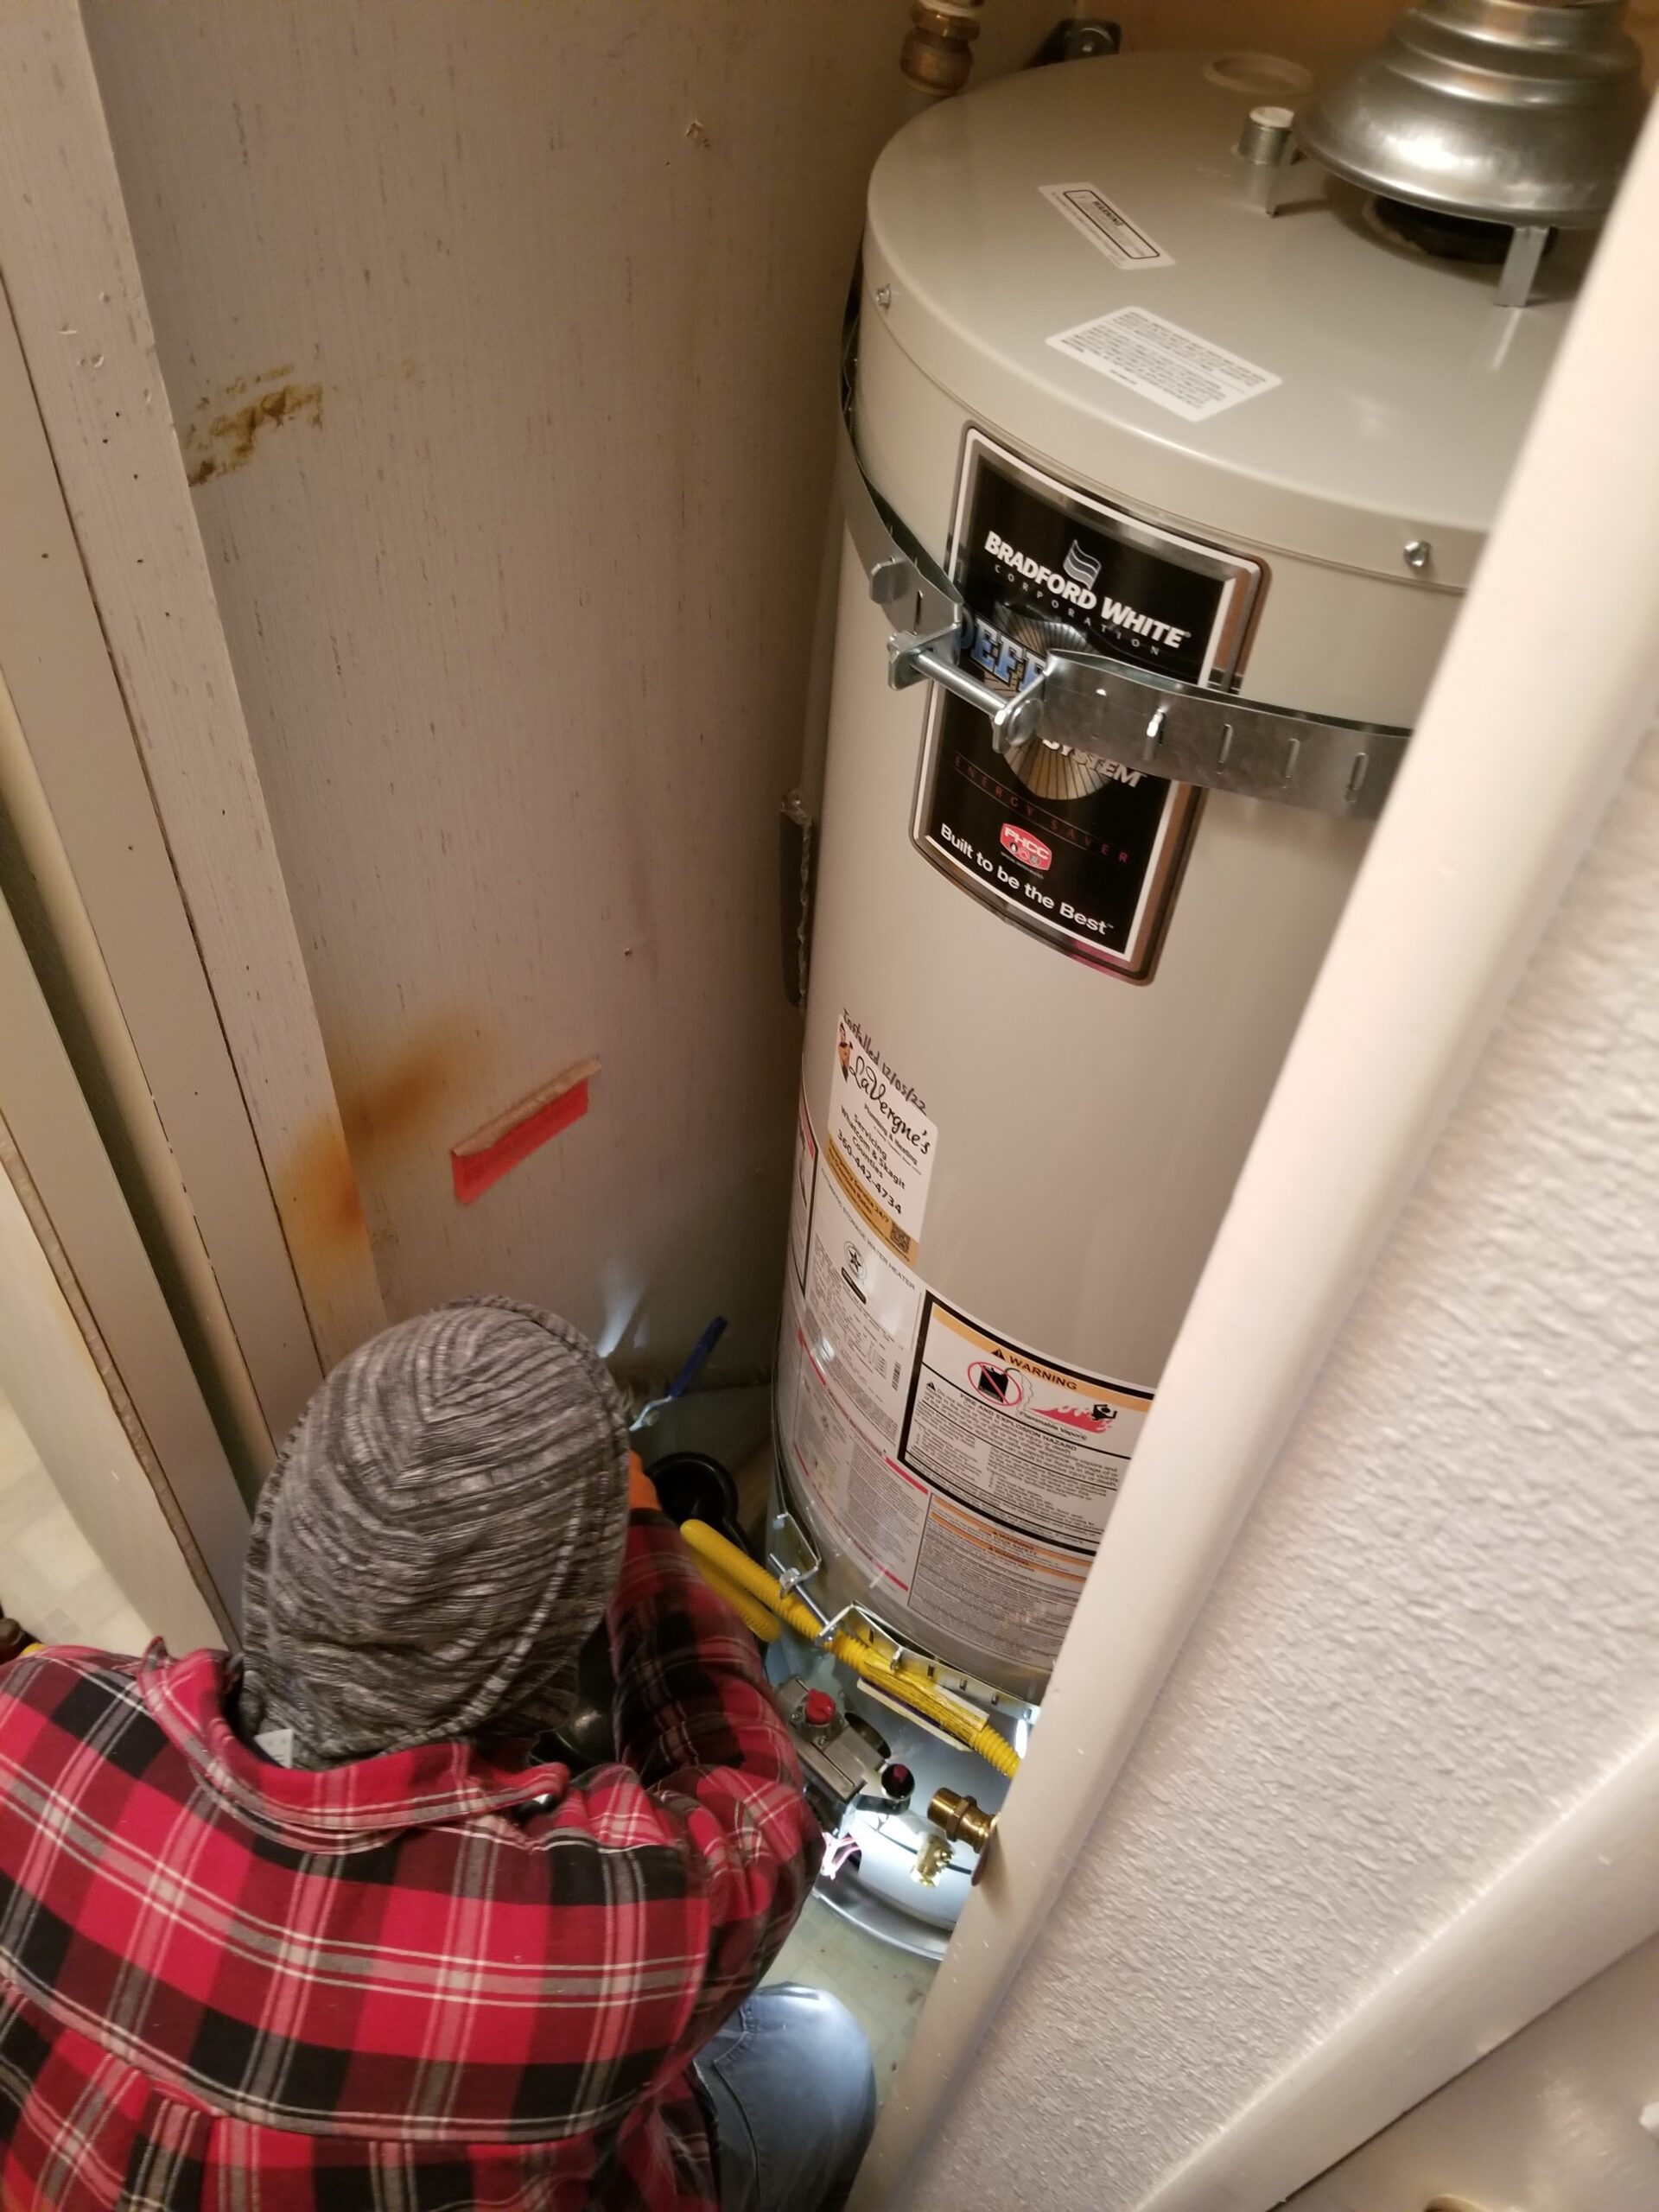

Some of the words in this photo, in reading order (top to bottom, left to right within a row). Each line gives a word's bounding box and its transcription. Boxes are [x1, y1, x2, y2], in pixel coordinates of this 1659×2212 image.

[984, 531, 1097, 610] BRADFORD
[995, 563, 1160, 656] CORPORATION
[954, 754, 1035, 817] ENERGY
[1051, 819, 1129, 863] SAVER
[1005, 826, 1050, 860] PHCC
[941, 823, 974, 860] Built
[976, 852, 994, 874] to
[996, 865, 1020, 890] be
[1024, 882, 1055, 910] the
[849, 1055, 931, 1155] LaVergne's
[855, 1114, 887, 1160] Servicing
[838, 1128, 901, 1214] 360-442-4734
[841, 1105, 870, 1152] Whatcom
[872, 1150, 878, 1161] &
[880, 1158, 906, 1190] Skagit
[852, 1136, 883, 1179] Counties
[888, 1262, 916, 1291] HEATER
[1008, 1355, 1077, 1390] WARNING
[959, 1393, 977, 1407] FIRE
[977, 1404, 995, 1416] AND
[995, 1413, 1040, 1438] EXPLOSION
[1042, 1434, 1077, 1452] HAZARD
[1020, 1410, 1058, 1432] Flammable
